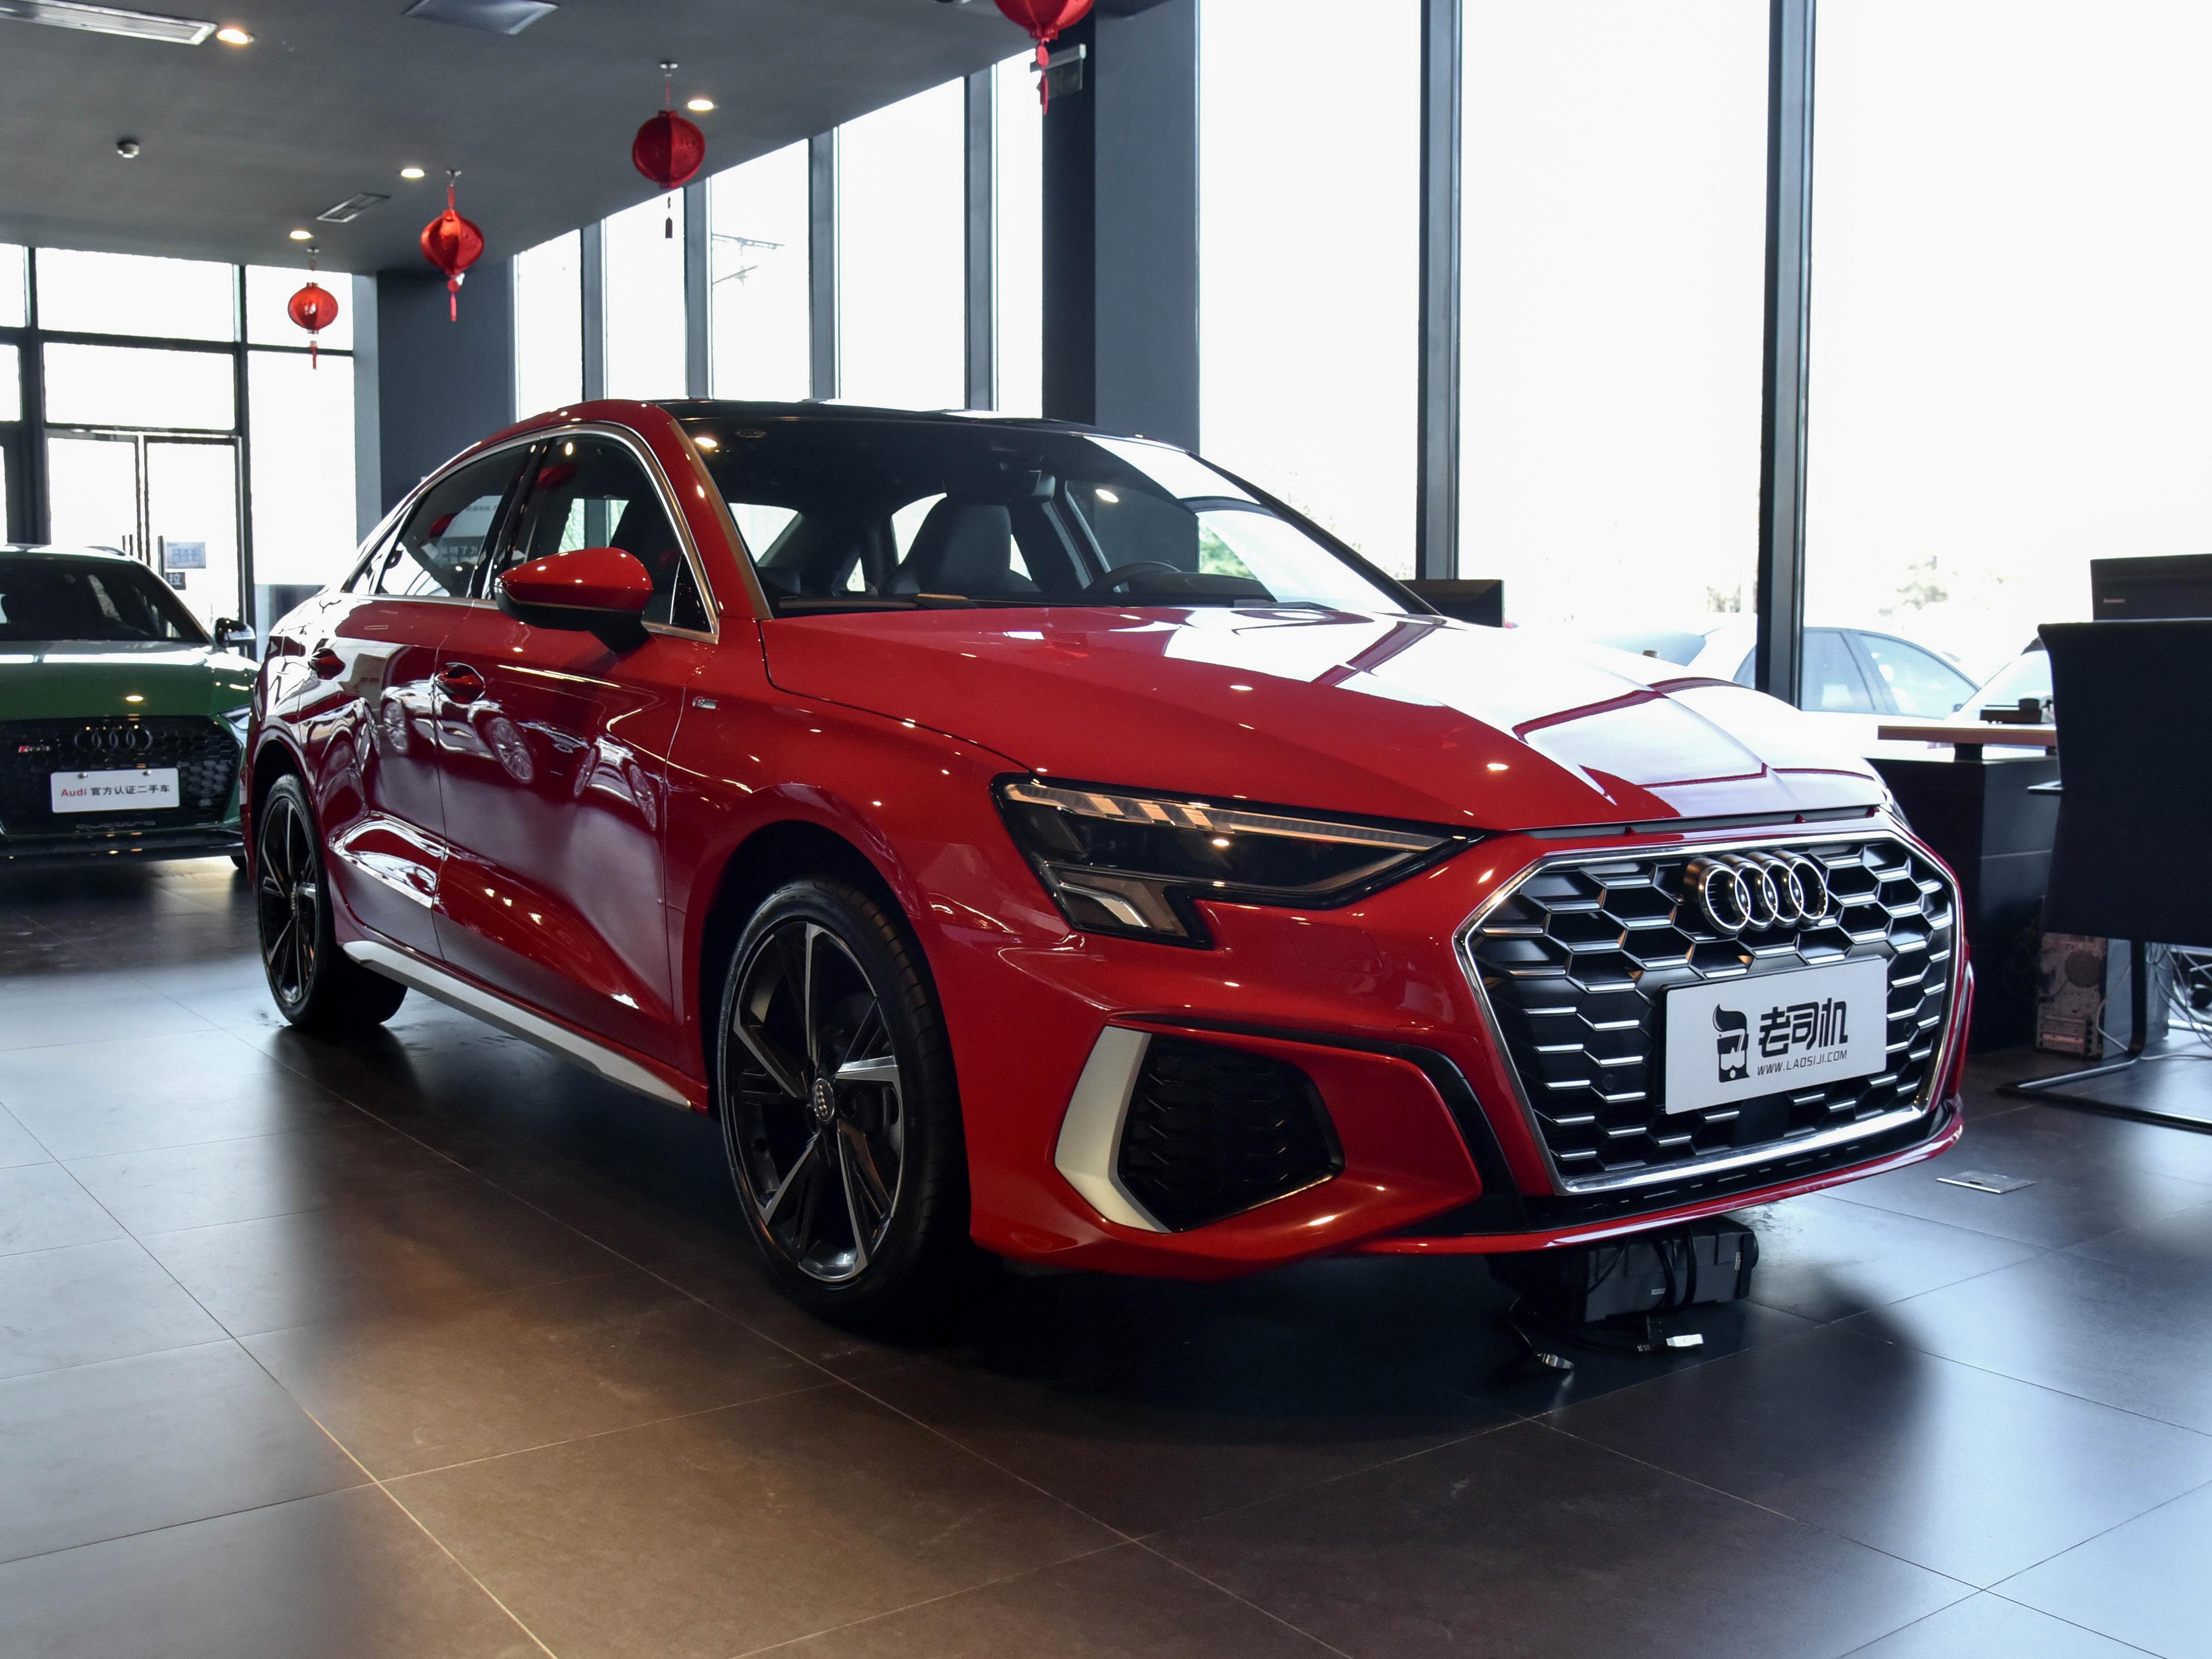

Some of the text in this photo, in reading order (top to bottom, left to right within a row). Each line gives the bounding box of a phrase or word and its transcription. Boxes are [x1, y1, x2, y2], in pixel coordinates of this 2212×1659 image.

[168, 573, 182, 585] 拉
[61, 784, 170, 797] Audi 官方认证二手车
[1758, 997, 1849, 1058] 老司机
[1757, 1050, 1848, 1076] WWW.LAOSIJI.COM
